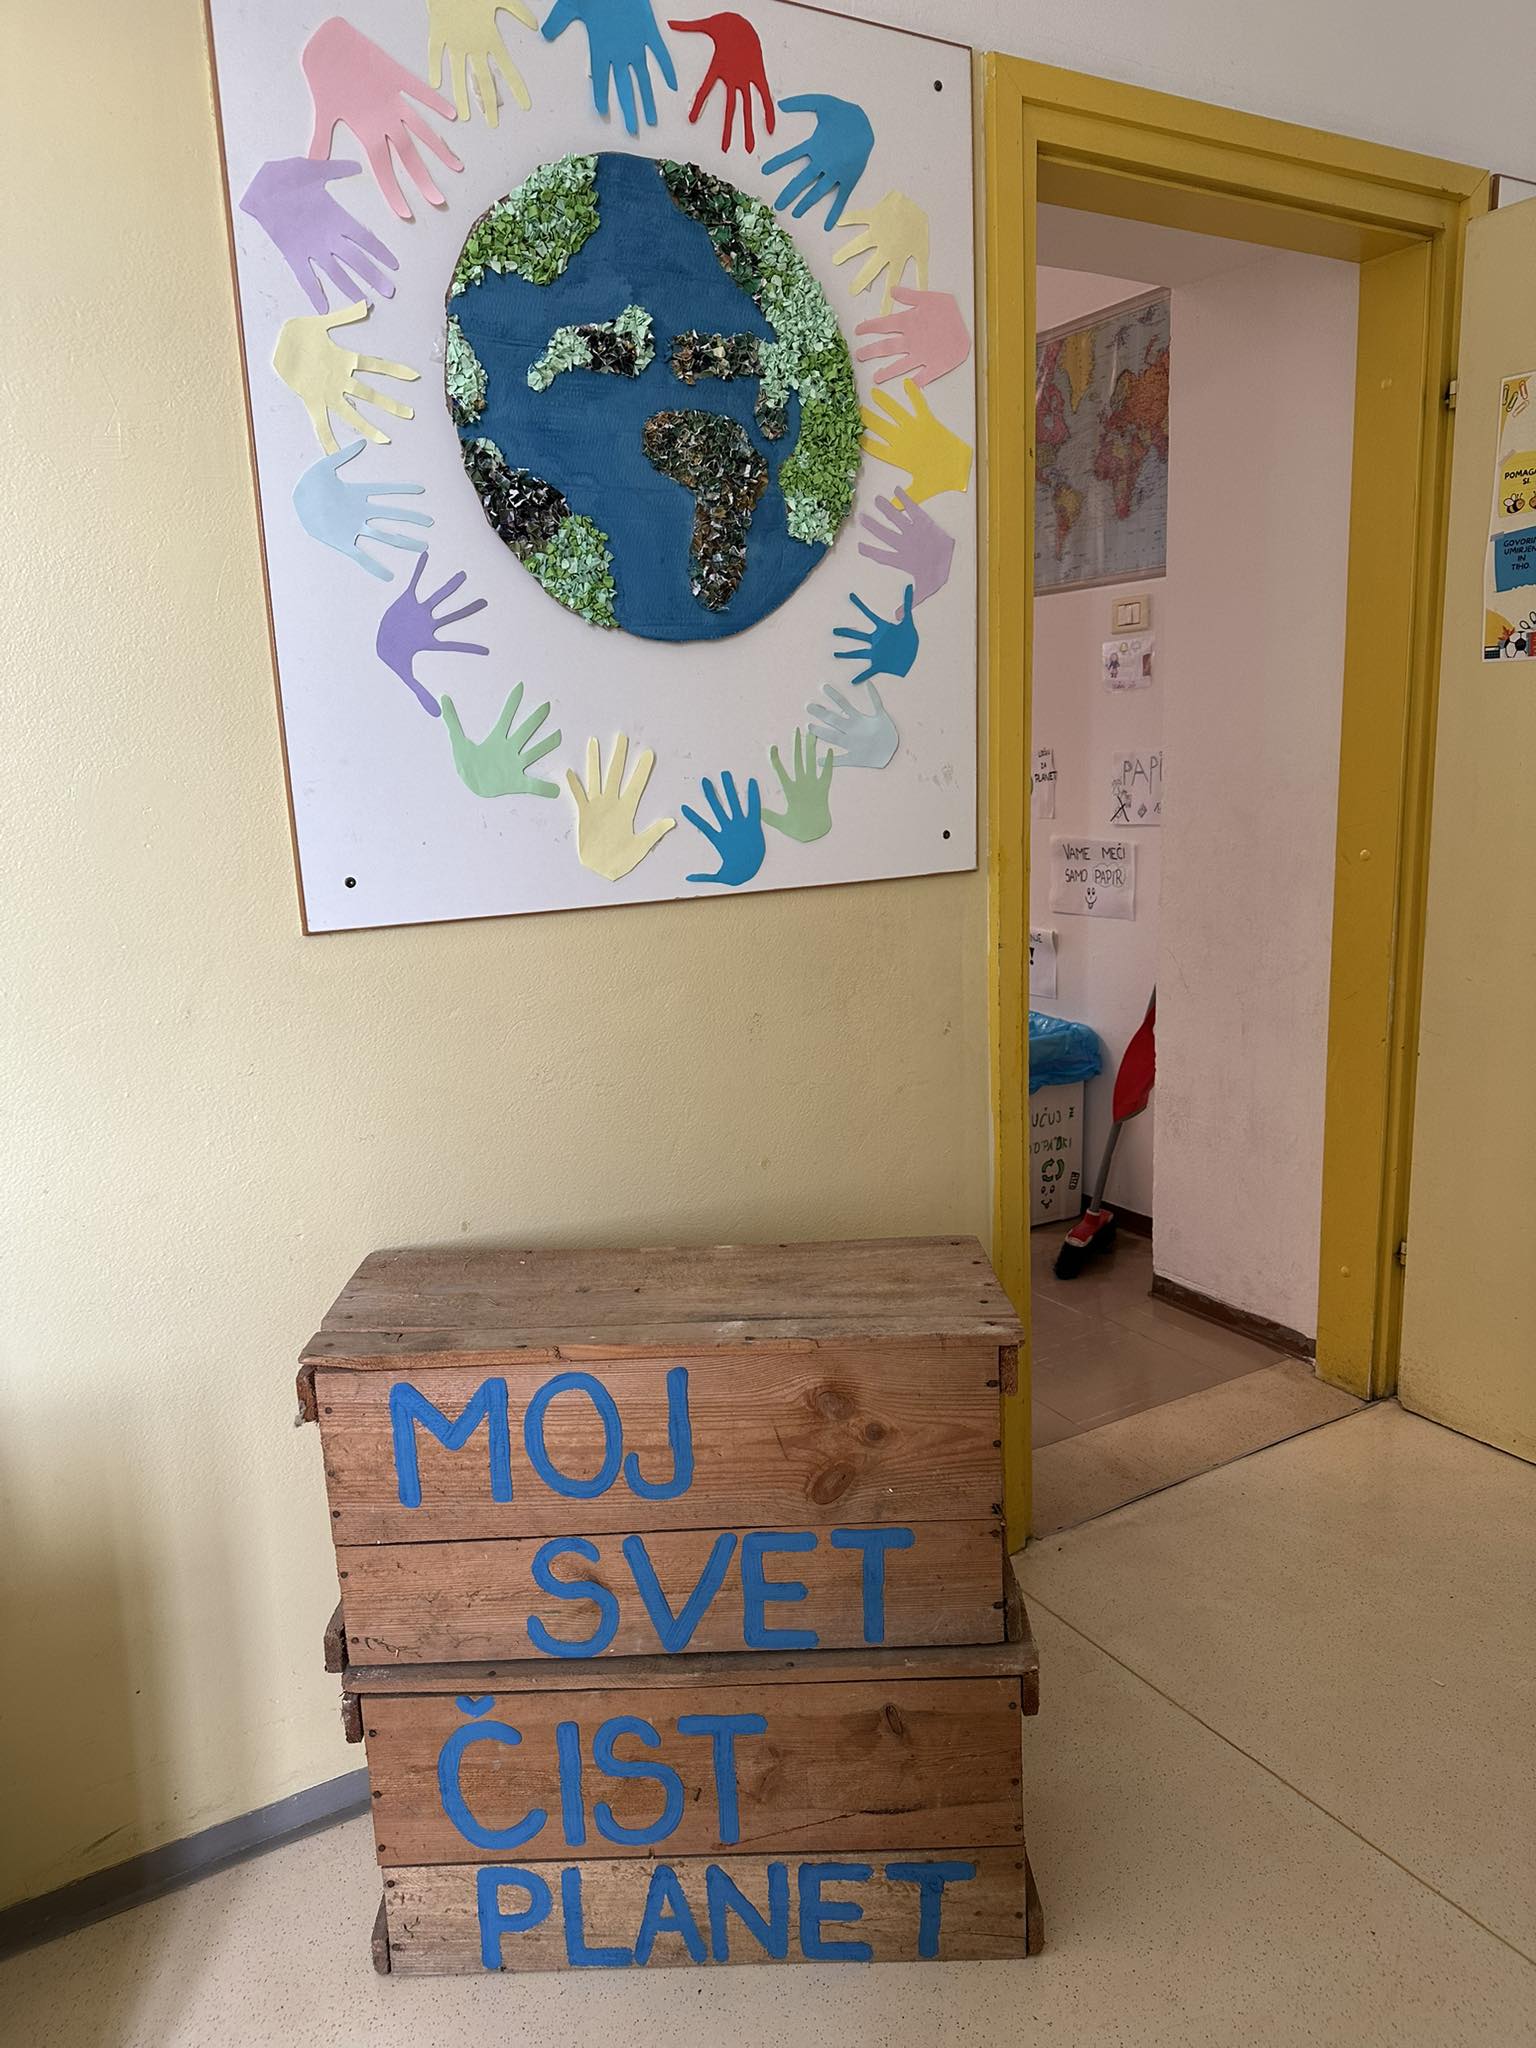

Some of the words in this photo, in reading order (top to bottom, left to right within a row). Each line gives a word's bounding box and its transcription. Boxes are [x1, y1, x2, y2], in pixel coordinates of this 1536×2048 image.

[1504, 468, 1536, 480] POMAG
[1517, 554, 1526, 562] IN
[1062, 843, 1091, 860] VAME
[1065, 868, 1089, 883] SAMO
[1094, 868, 1125, 886] PAPIR
[389, 1367, 694, 1508] MOJ
[527, 1527, 915, 1658] SVET
[438, 1695, 768, 1849] ČIST
[477, 1861, 976, 1969] PLANET
